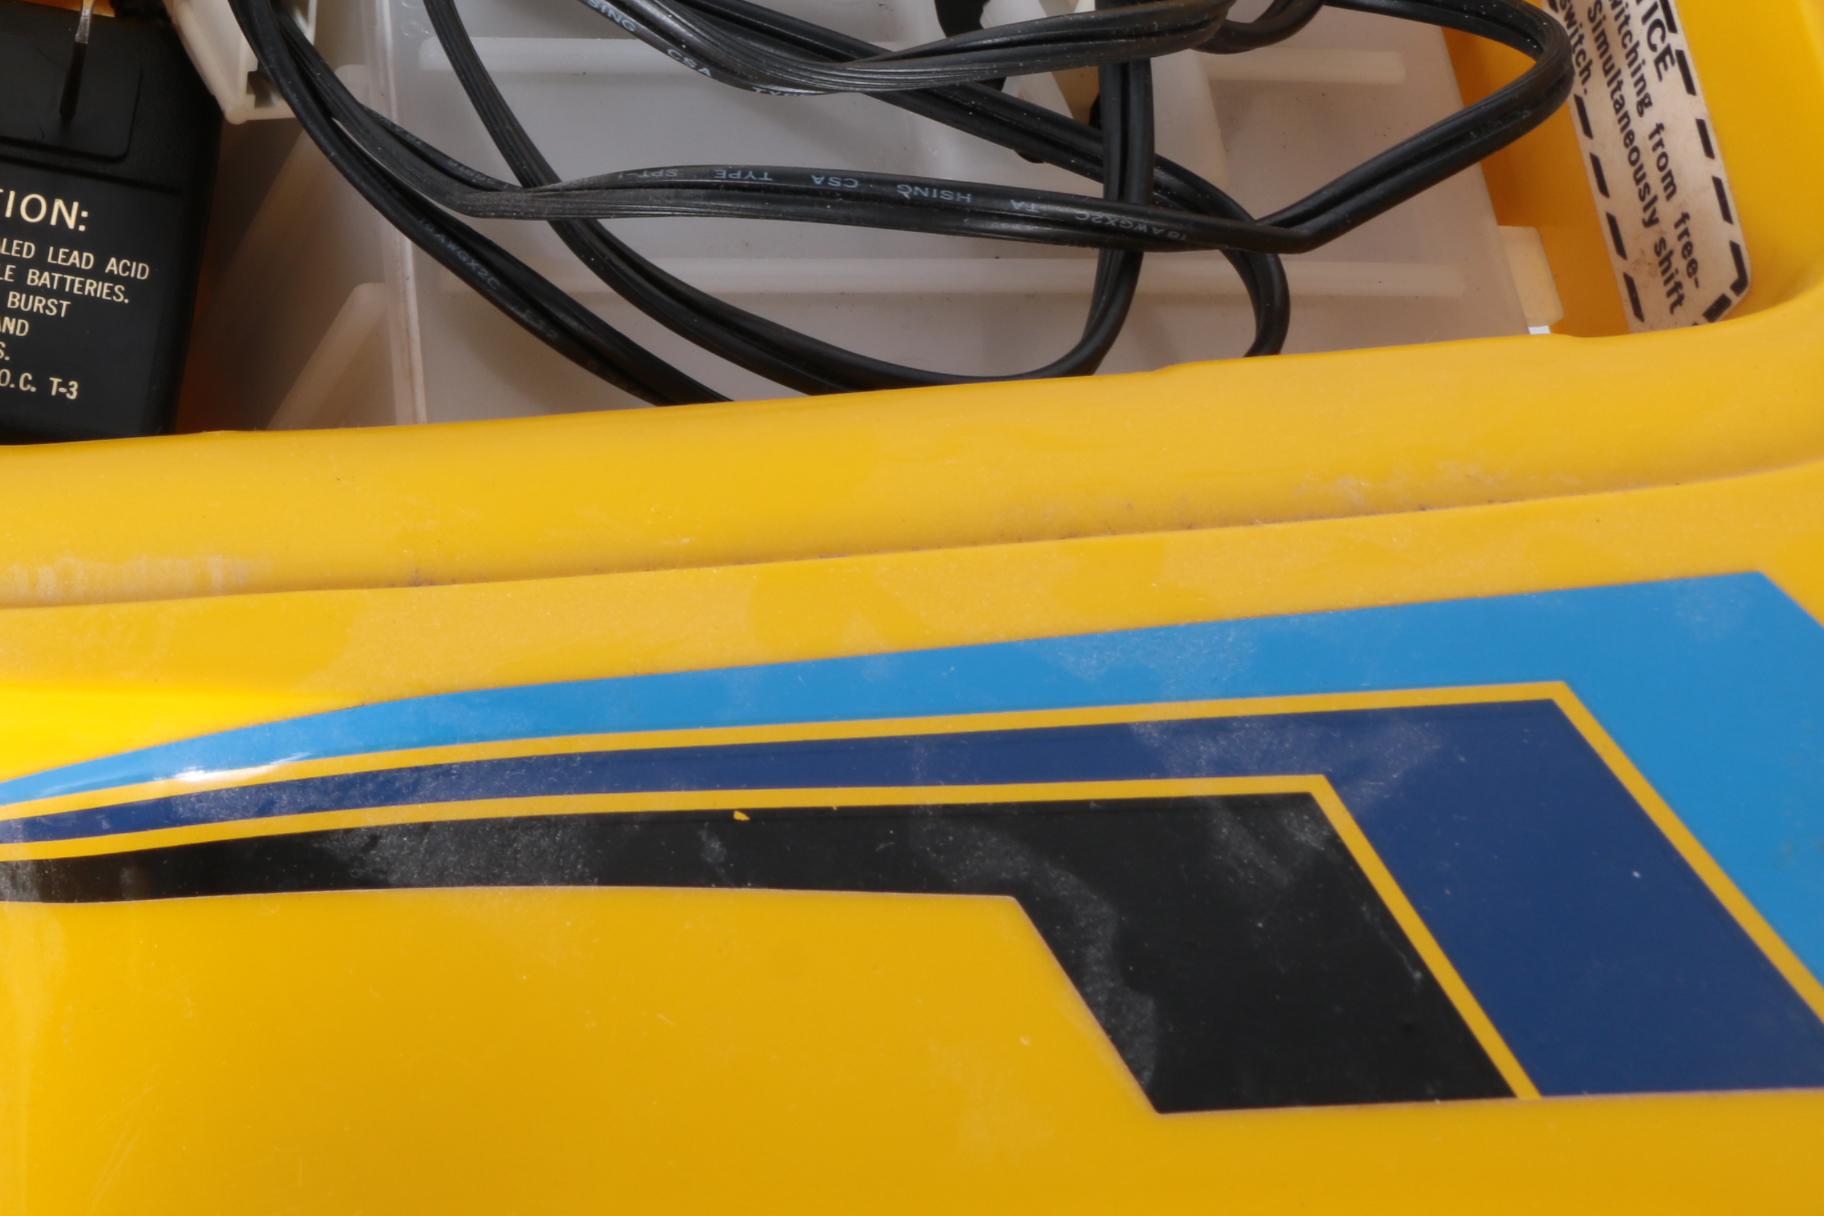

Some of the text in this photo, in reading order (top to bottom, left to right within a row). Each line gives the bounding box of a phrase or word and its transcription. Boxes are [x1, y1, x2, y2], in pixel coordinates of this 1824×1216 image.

[666, 46, 713, 80] CSA
[713, 167, 775, 183] TYPE
[812, 173, 860, 190] CSA
[1009, 198, 1040, 212] TA
[1647, 122, 1677, 201] from
[1673, 211, 1701, 288] free-
[47, 245, 95, 270] LEAD
[105, 257, 150, 280] ACID
[1652, 237, 1687, 315] shift
[27, 268, 130, 304] BATTERIES.
[7, 291, 71, 318] BURST
[49, 377, 79, 400] T-3
